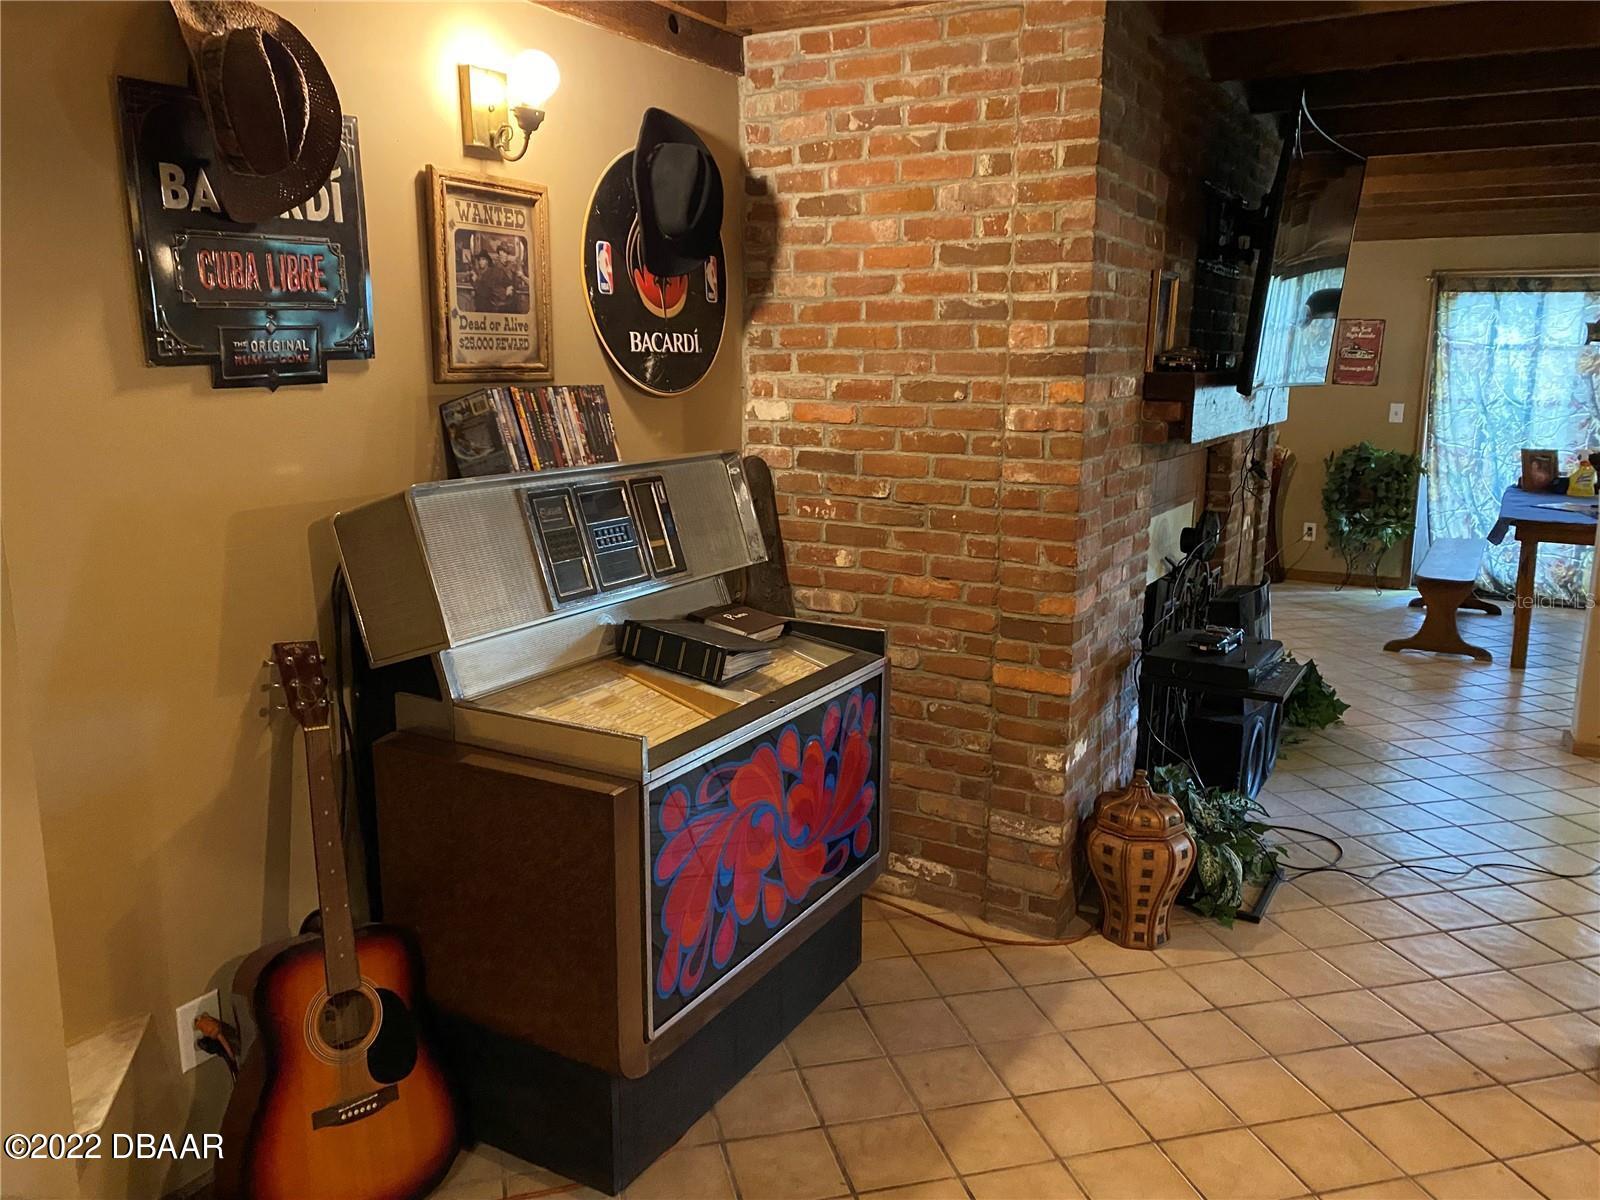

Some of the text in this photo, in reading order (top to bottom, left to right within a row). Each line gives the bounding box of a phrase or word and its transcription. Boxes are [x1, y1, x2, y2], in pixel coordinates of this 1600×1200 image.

[158, 162, 344, 223] BADÍ
[455, 201, 526, 229] WANTED
[196, 250, 327, 293] CUBA LIBRE
[459, 315, 529, 333] Dead or Alive
[250, 339, 310, 353] ORIGINAL
[495, 337, 529, 352] REWARD
[629, 328, 699, 353] BACARDÍ
